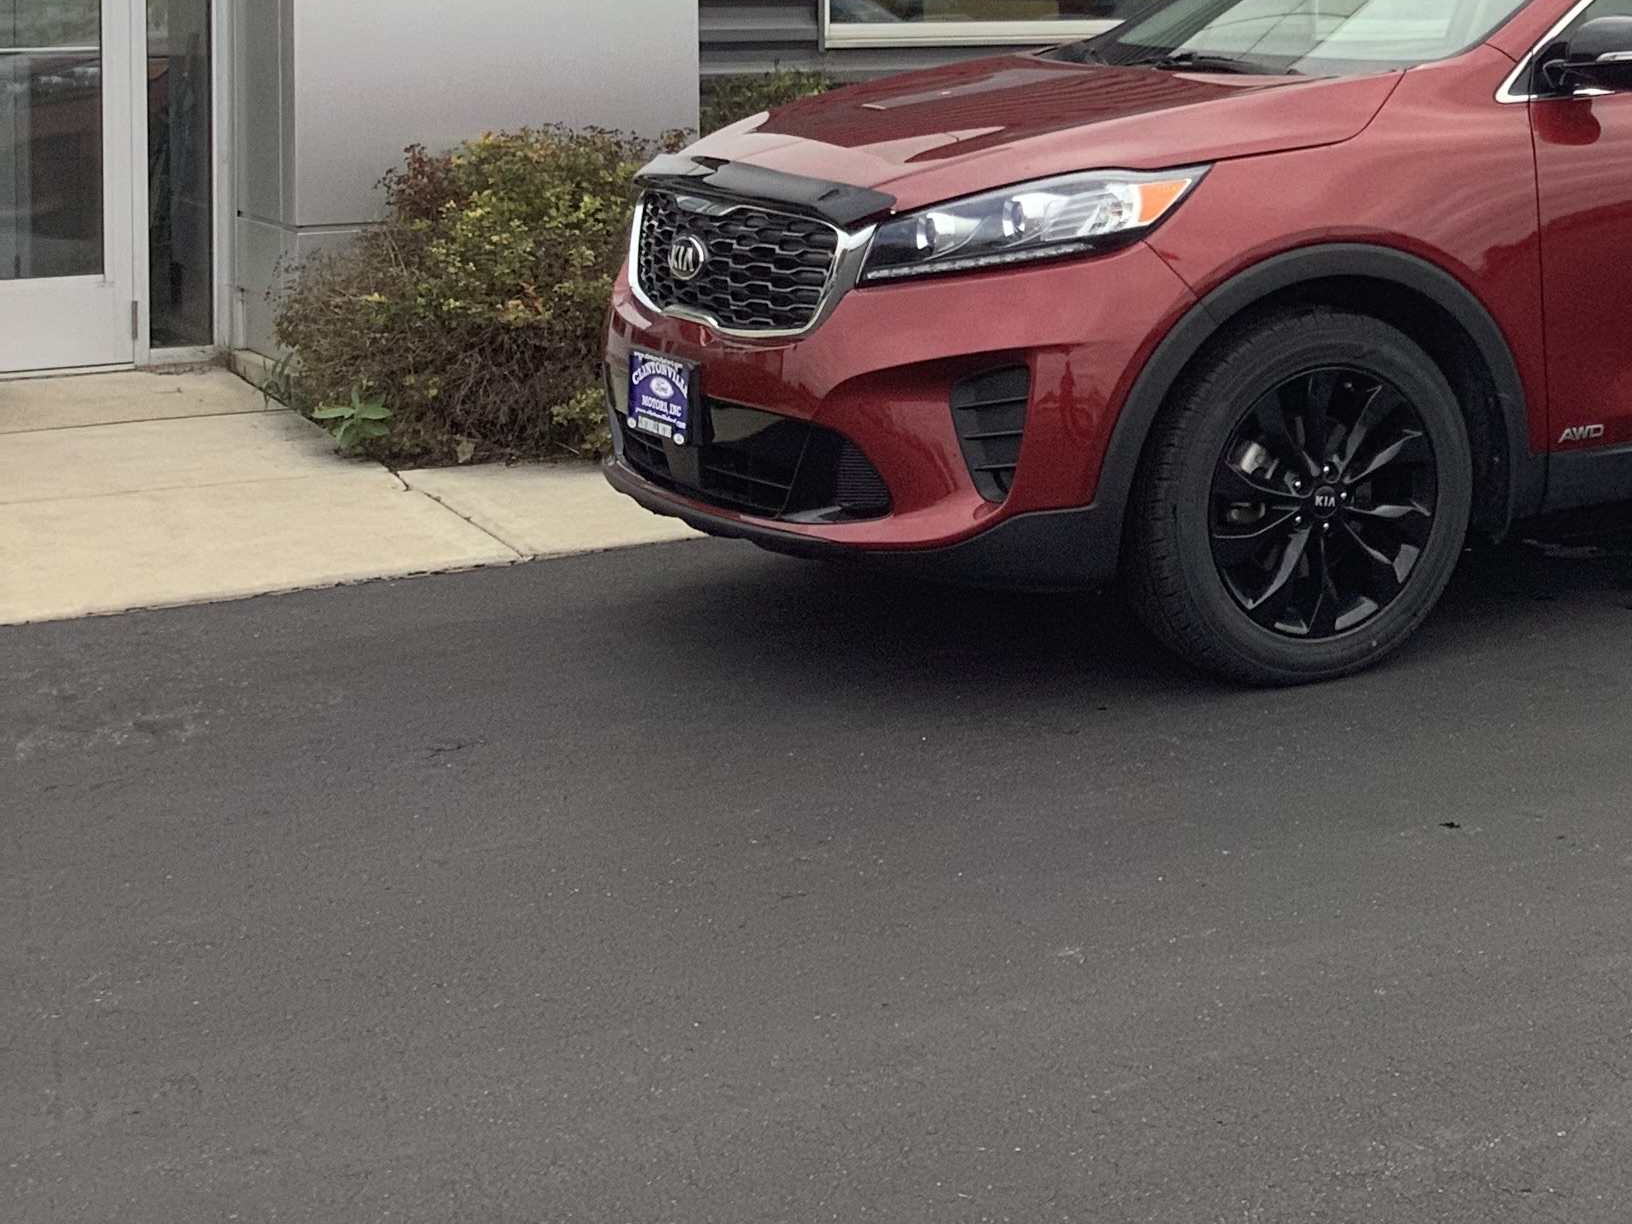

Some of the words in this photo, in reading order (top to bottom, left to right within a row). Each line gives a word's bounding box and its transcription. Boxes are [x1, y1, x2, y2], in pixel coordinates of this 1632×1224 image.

[670, 244, 695, 272] KIA
[1558, 423, 1605, 444] AWD
[1315, 495, 1336, 507] KIA
